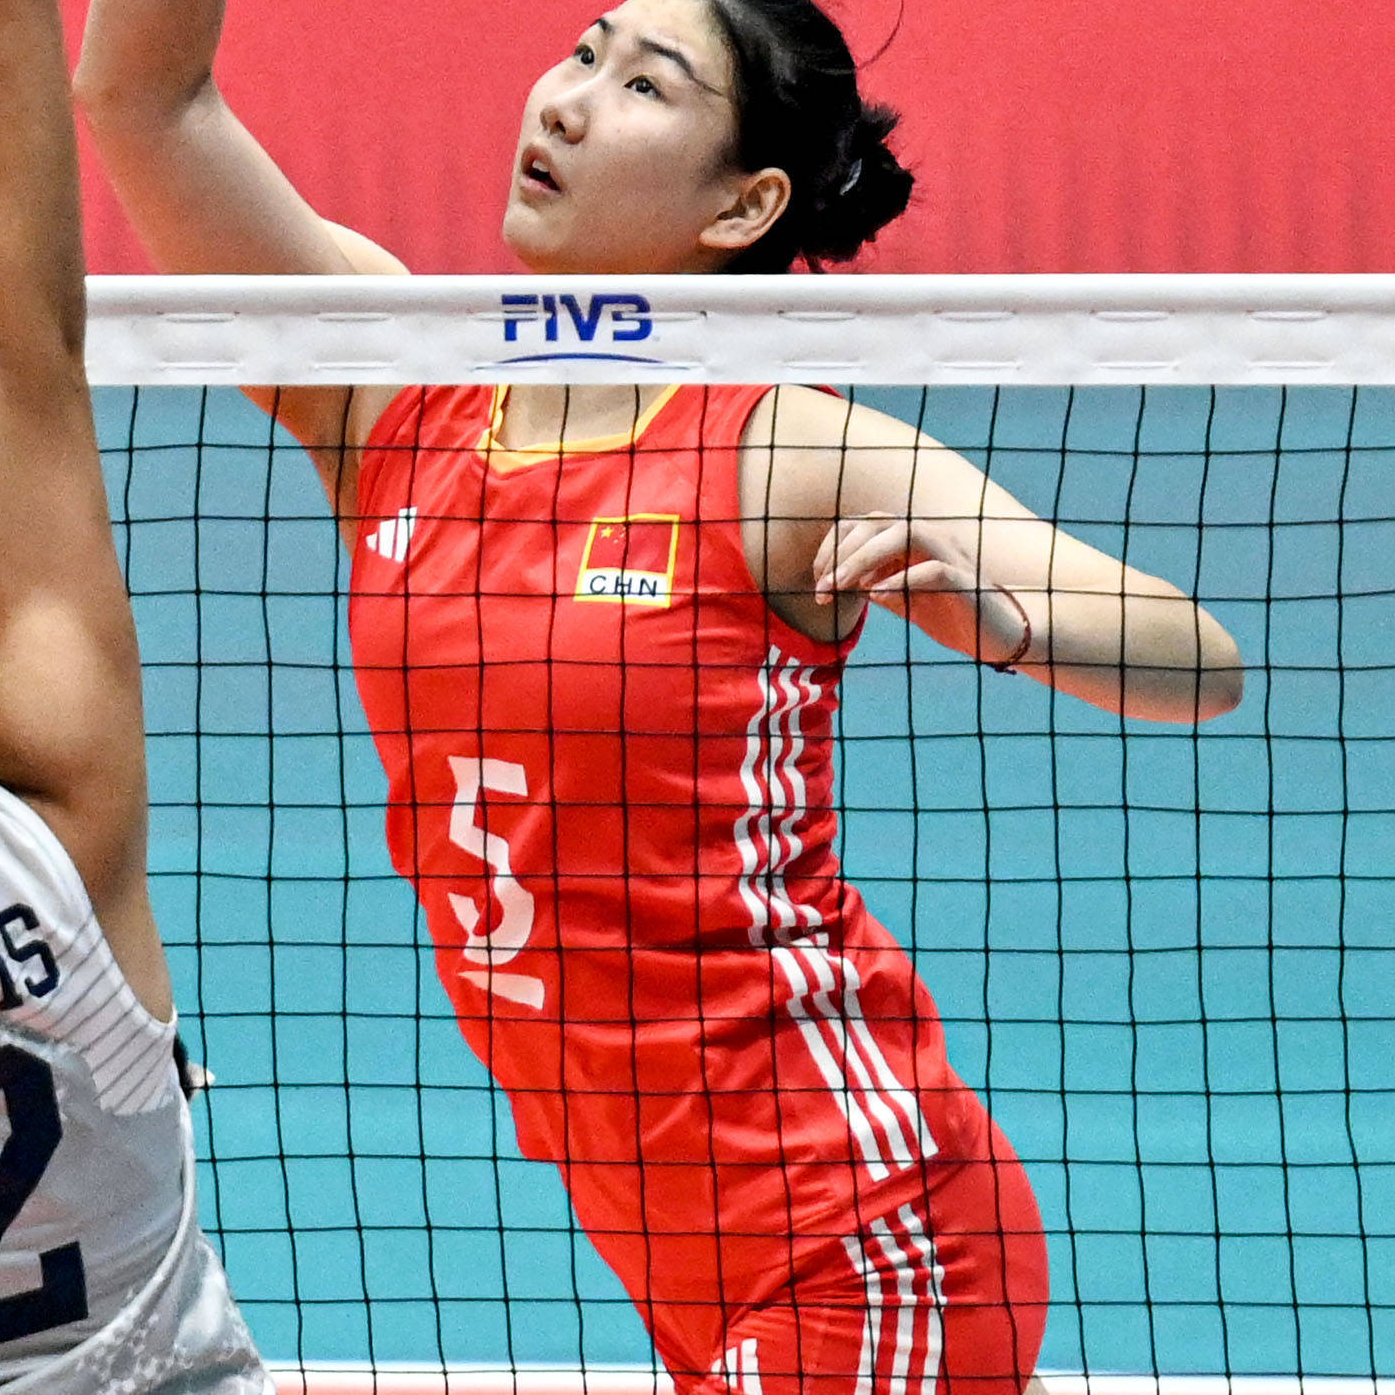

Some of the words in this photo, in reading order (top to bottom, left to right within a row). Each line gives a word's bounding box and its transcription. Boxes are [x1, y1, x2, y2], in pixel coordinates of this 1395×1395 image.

[501, 294, 653, 342] FIVB
[590, 575, 658, 597] CHN
[447, 755, 535, 966] 5
